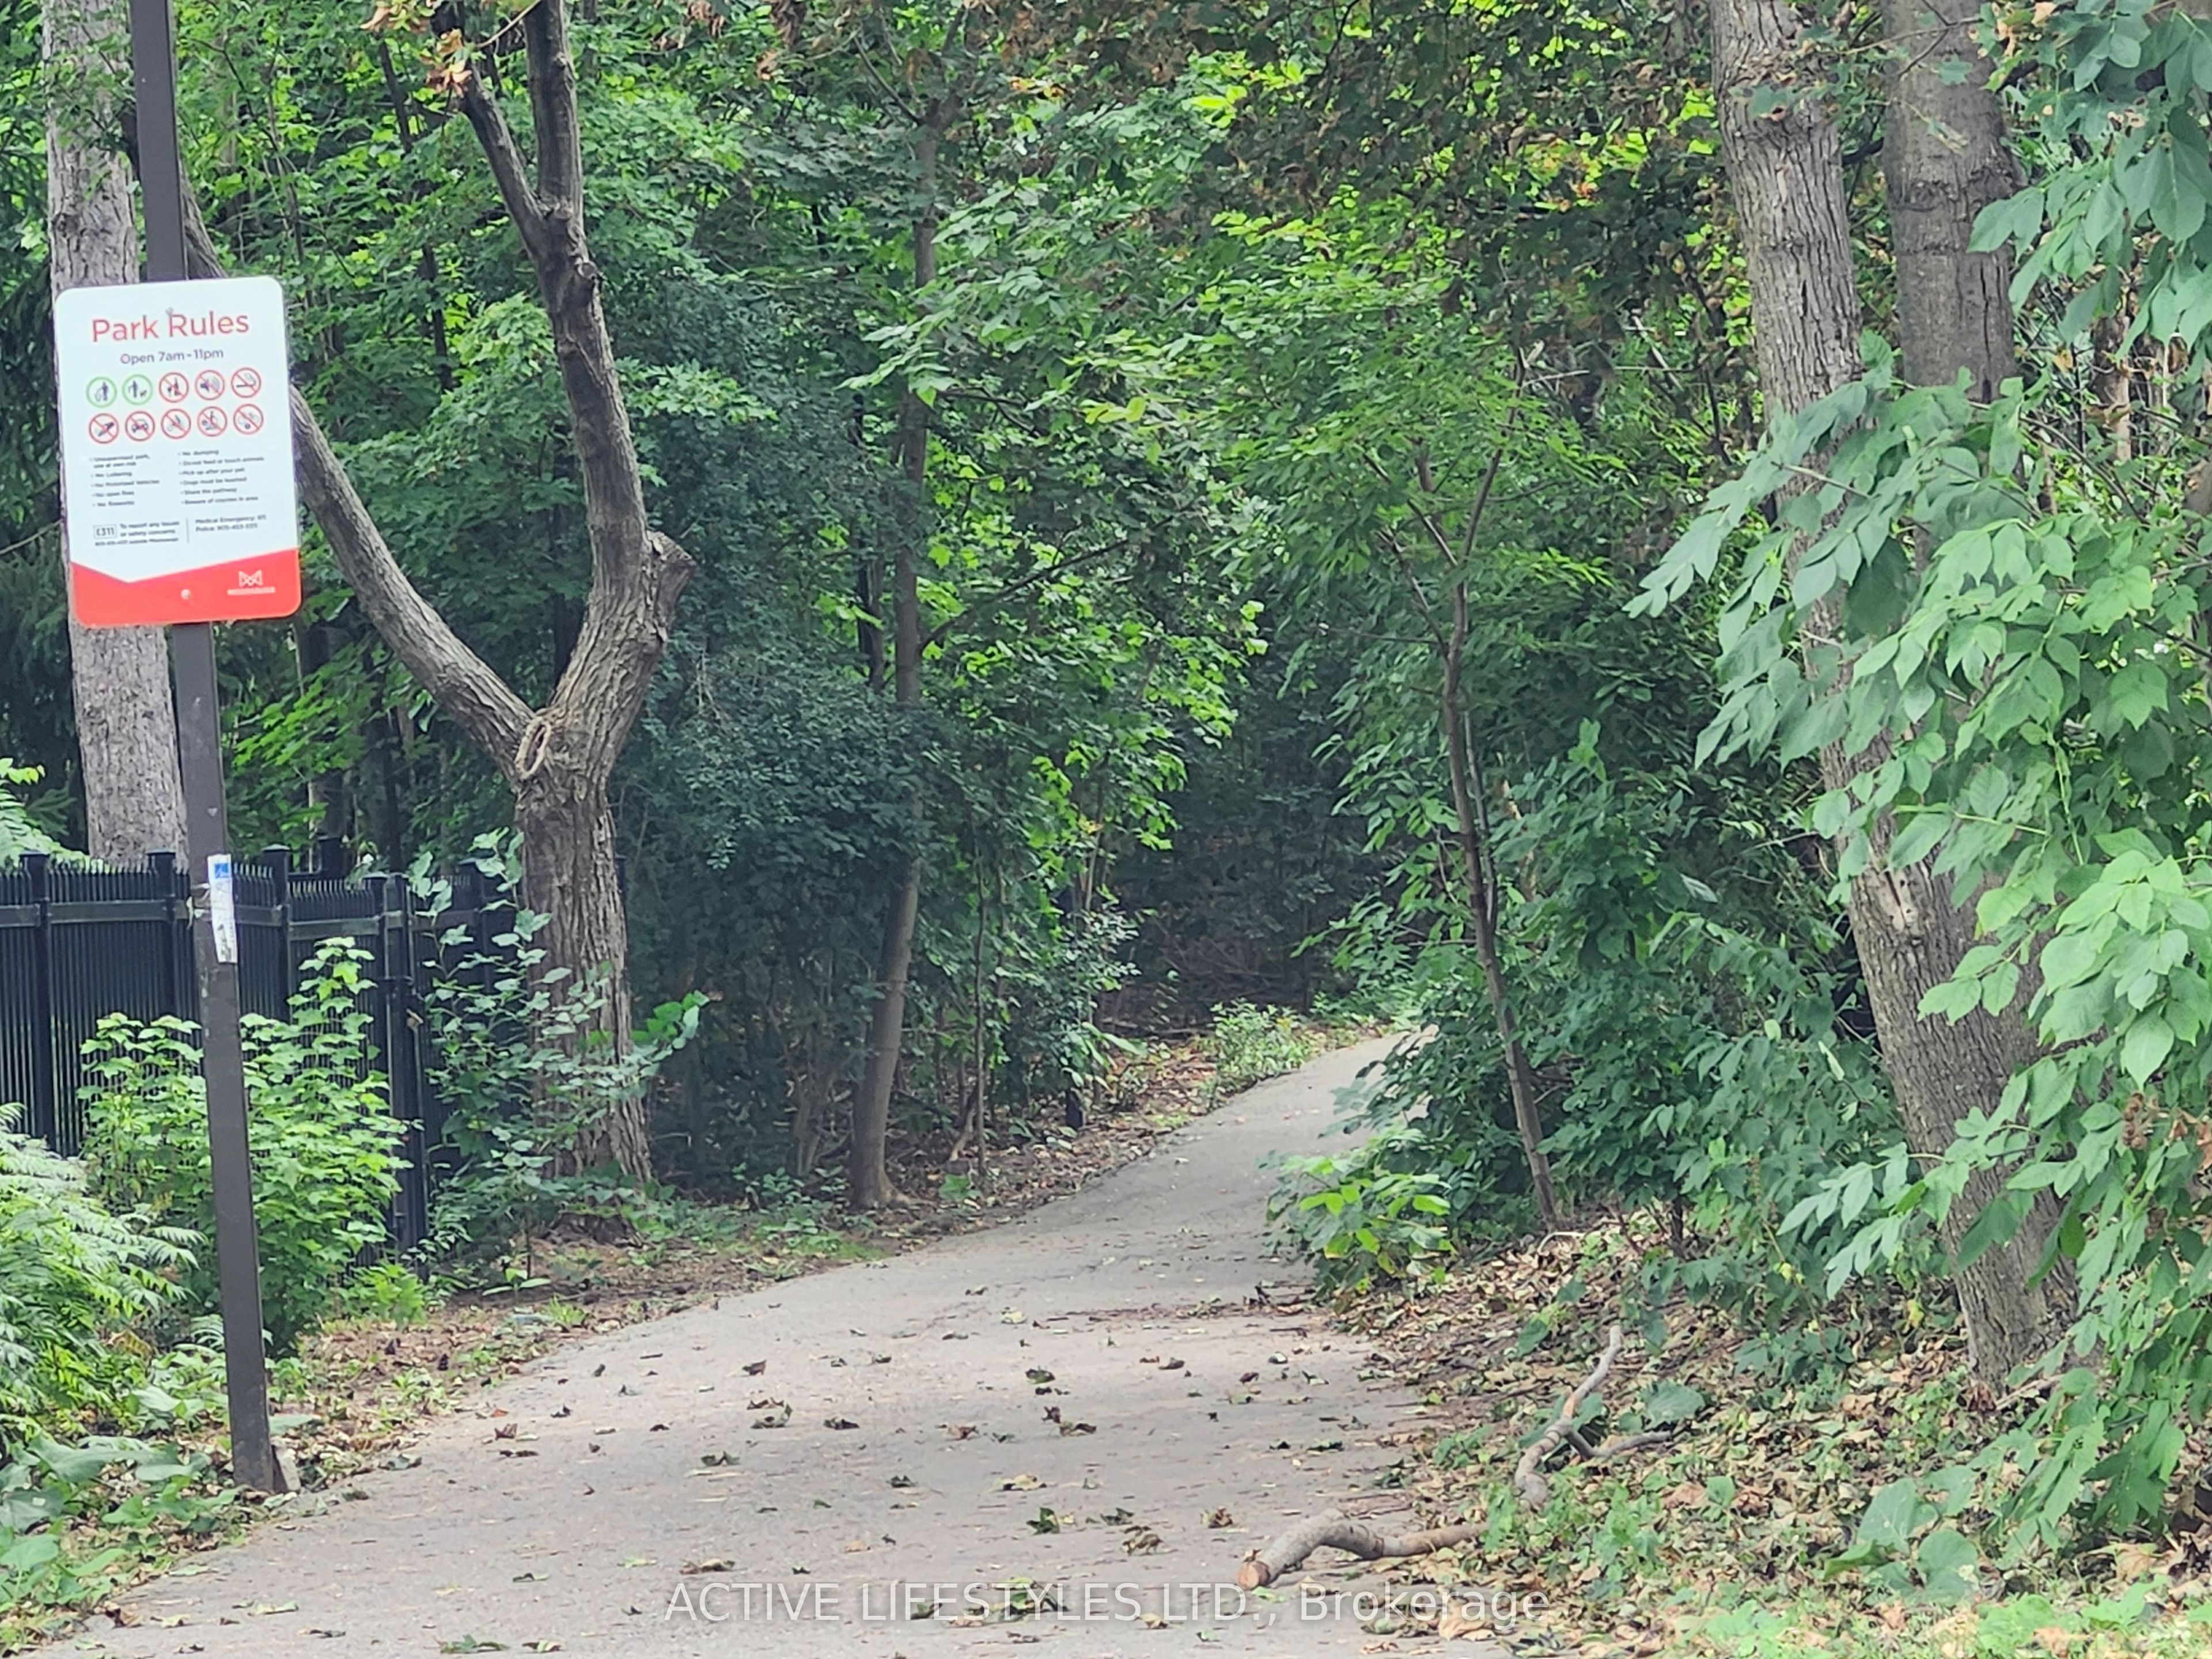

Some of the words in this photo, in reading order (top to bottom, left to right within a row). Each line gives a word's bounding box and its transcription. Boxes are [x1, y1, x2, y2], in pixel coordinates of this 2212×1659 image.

[92, 315, 159, 342] Park
[169, 310, 249, 338] Rules
[120, 353, 154, 365] Open
